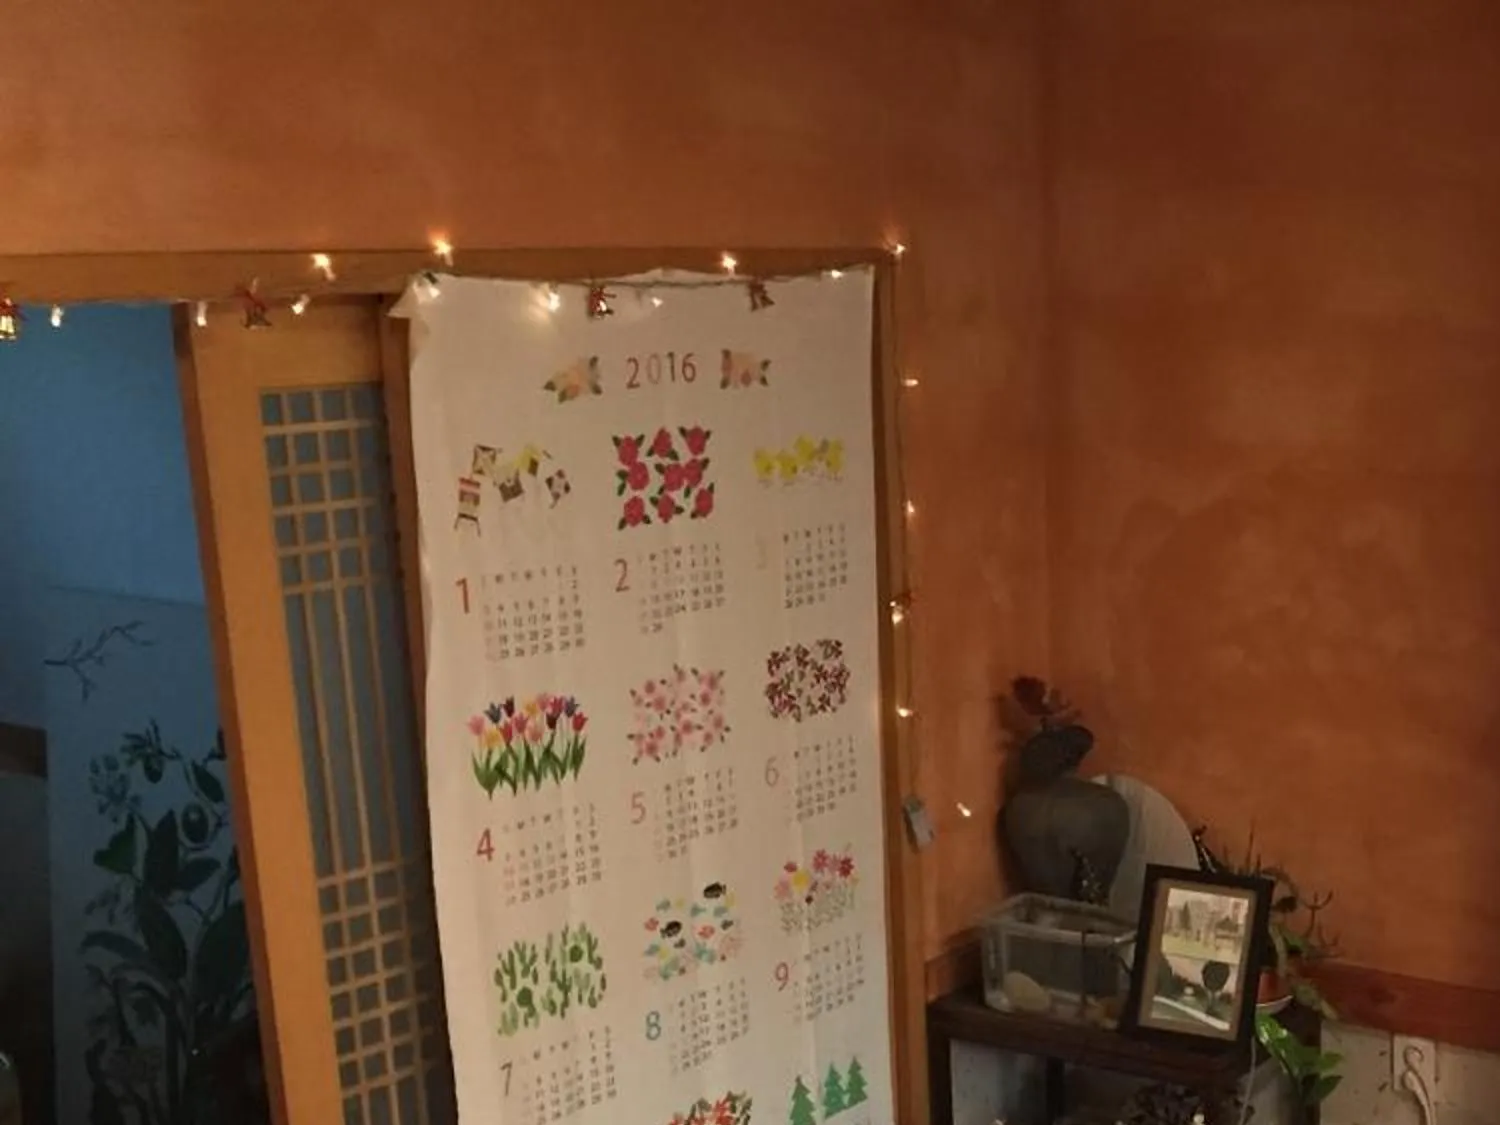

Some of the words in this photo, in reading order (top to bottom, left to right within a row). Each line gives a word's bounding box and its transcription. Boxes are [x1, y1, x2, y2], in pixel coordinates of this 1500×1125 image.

[626, 351, 696, 389] 2016
[614, 558, 630, 592] 2
[456, 577, 470, 614] 1
[765, 756, 779, 787] 6
[631, 791, 646, 824] 5
[477, 827, 495, 861] 4
[775, 961, 789, 992] 9
[646, 1010, 661, 1041] 8
[500, 1061, 513, 1098] 7
